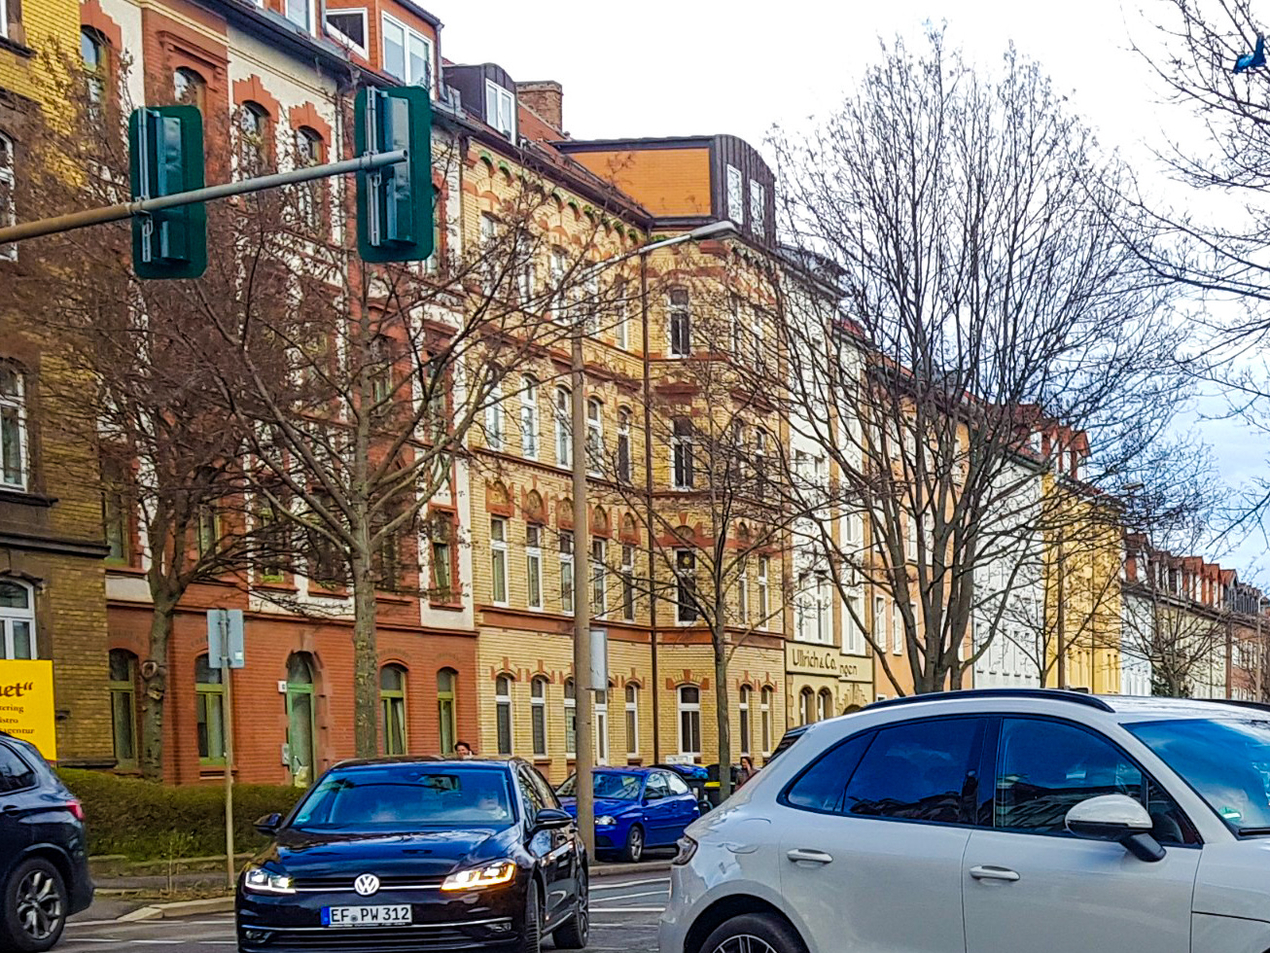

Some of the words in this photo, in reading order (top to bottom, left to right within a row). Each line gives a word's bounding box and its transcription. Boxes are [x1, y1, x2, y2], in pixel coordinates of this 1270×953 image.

[331, 908, 350, 923] EF
[361, 907, 379, 922] PW
[382, 906, 410, 921] 312
